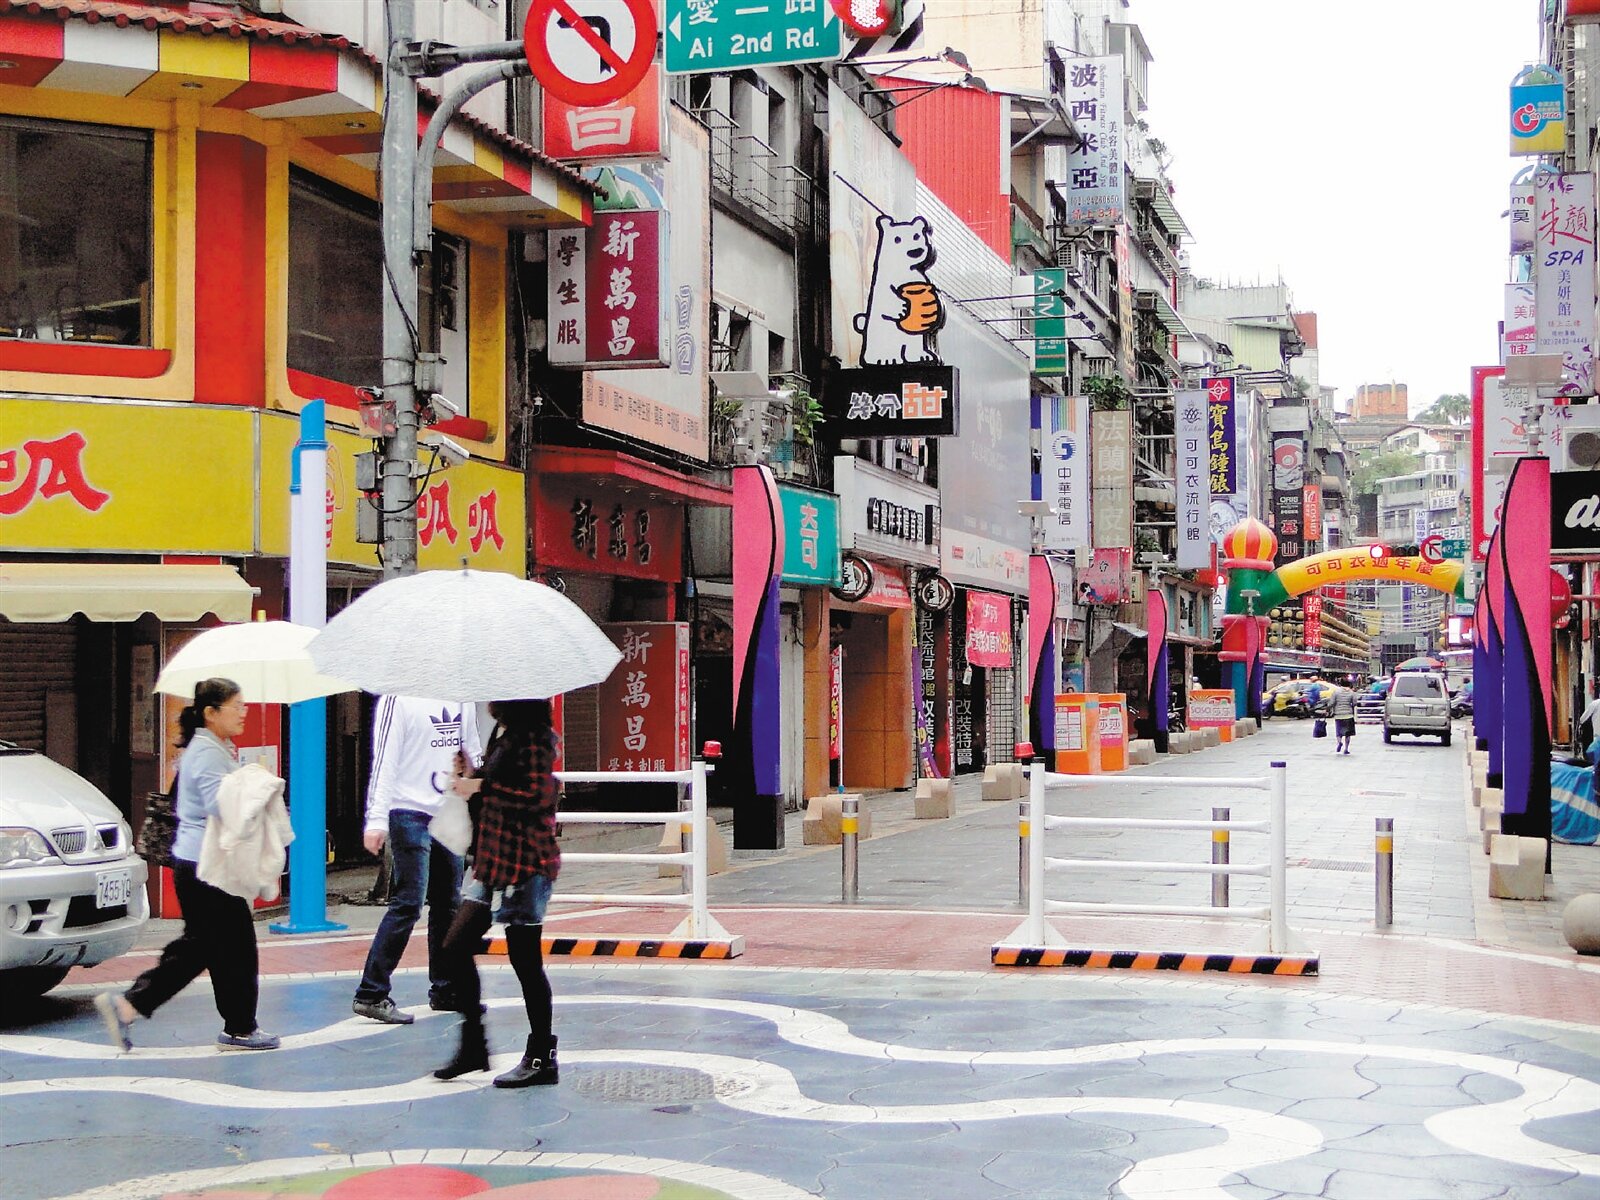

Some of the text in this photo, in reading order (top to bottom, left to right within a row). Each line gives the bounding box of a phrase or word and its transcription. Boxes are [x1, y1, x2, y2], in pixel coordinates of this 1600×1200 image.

[689, 28, 820, 59] Ai 2nd Rd.
[1108, 121, 1119, 188] 美容美體館
[1538, 198, 1592, 246] 朱顏
[1544, 250, 1584, 266] SPA
[557, 235, 580, 345] 學生服
[602, 220, 640, 357] 新萬昌
[1037, 275, 1055, 317] ATM
[1557, 269, 1572, 316] 美妍館
[417, 480, 504, 553] 呱呱
[1057, 467, 1072, 525] 中華電信
[1185, 439, 1200, 540] 可可衣流行館
[568, 498, 652, 566] 新萬昌
[1306, 555, 1433, 576] 可可衣週年慶
[621, 627, 653, 752] 新萬昌
[608, 757, 667, 772] 學生制服
